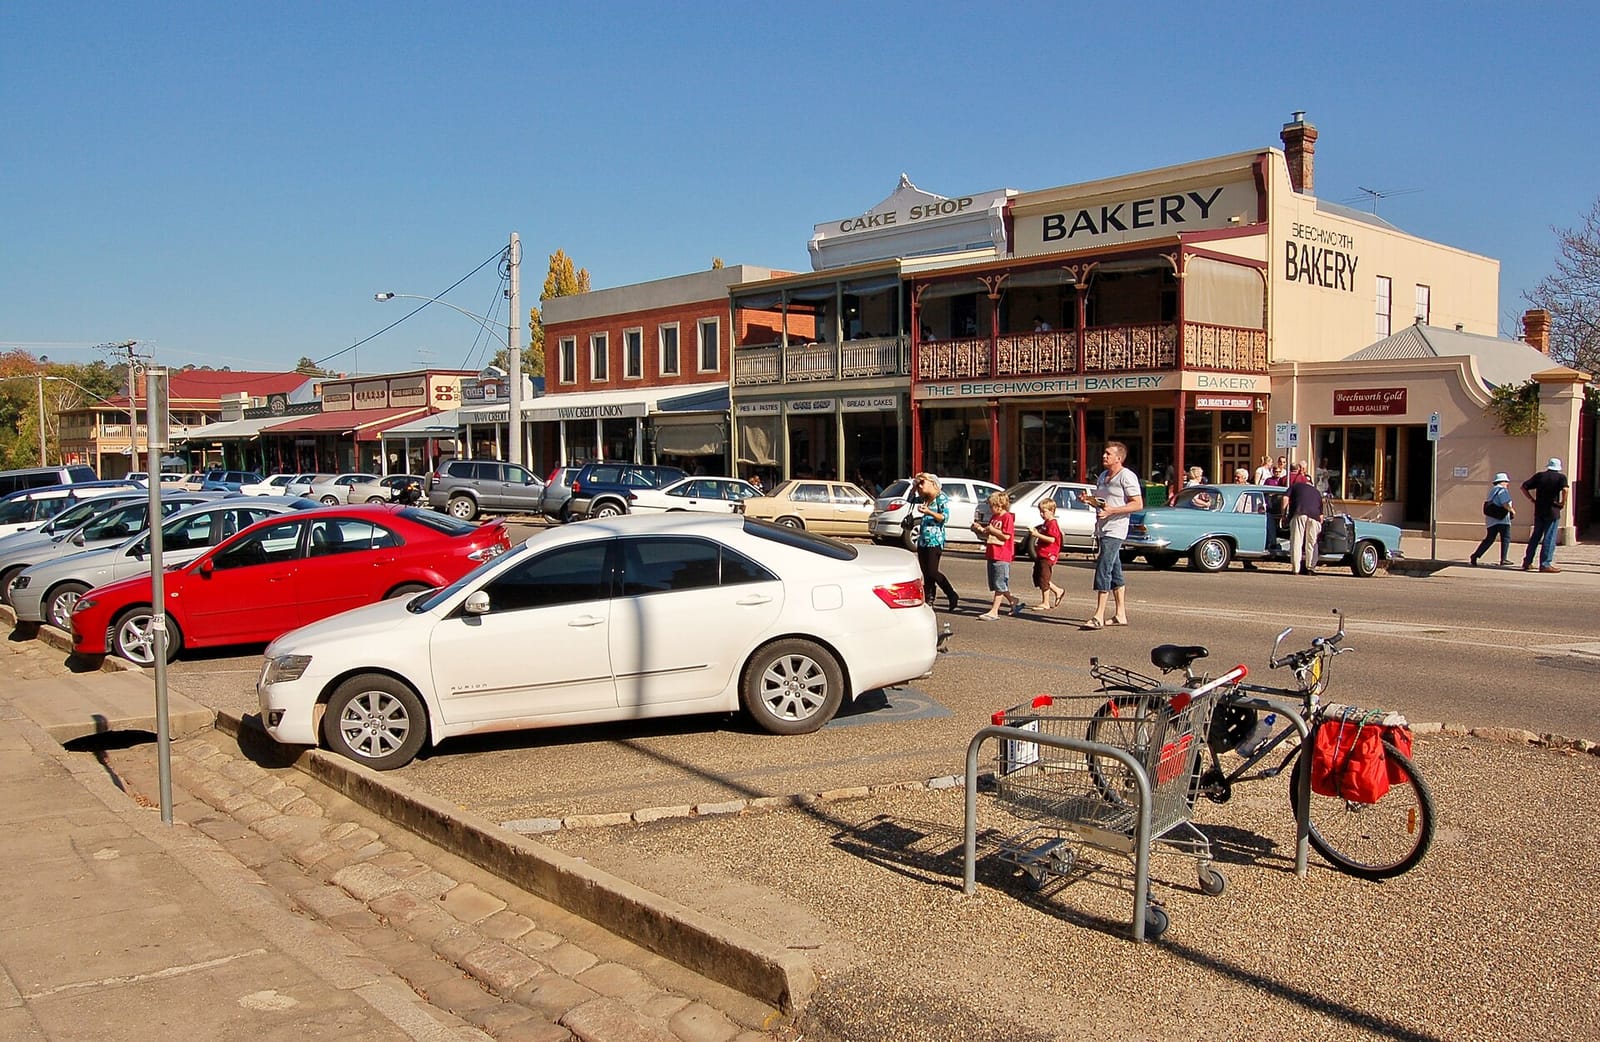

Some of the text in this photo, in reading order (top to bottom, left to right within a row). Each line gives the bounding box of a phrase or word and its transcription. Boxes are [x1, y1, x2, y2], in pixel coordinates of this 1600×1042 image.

[840, 197, 973, 233] CAKE SHOP
[1042, 187, 1224, 242] BAKERY
[1292, 222, 1354, 250] BEECHWORTH
[1285, 240, 1359, 293] BAKERY
[925, 375, 1163, 396] THE BEECHWORTH BAKERY
[1198, 375, 1257, 389] BAKERY
[1337, 390, 1405, 403] Beechworth Gold
[576, 406, 599, 417] CREDIT
[599, 404, 623, 416] UNION
[847, 400, 865, 408] BREAD
[488, 411, 507, 421] CREDIT
[1431, 415, 1437, 423] P
